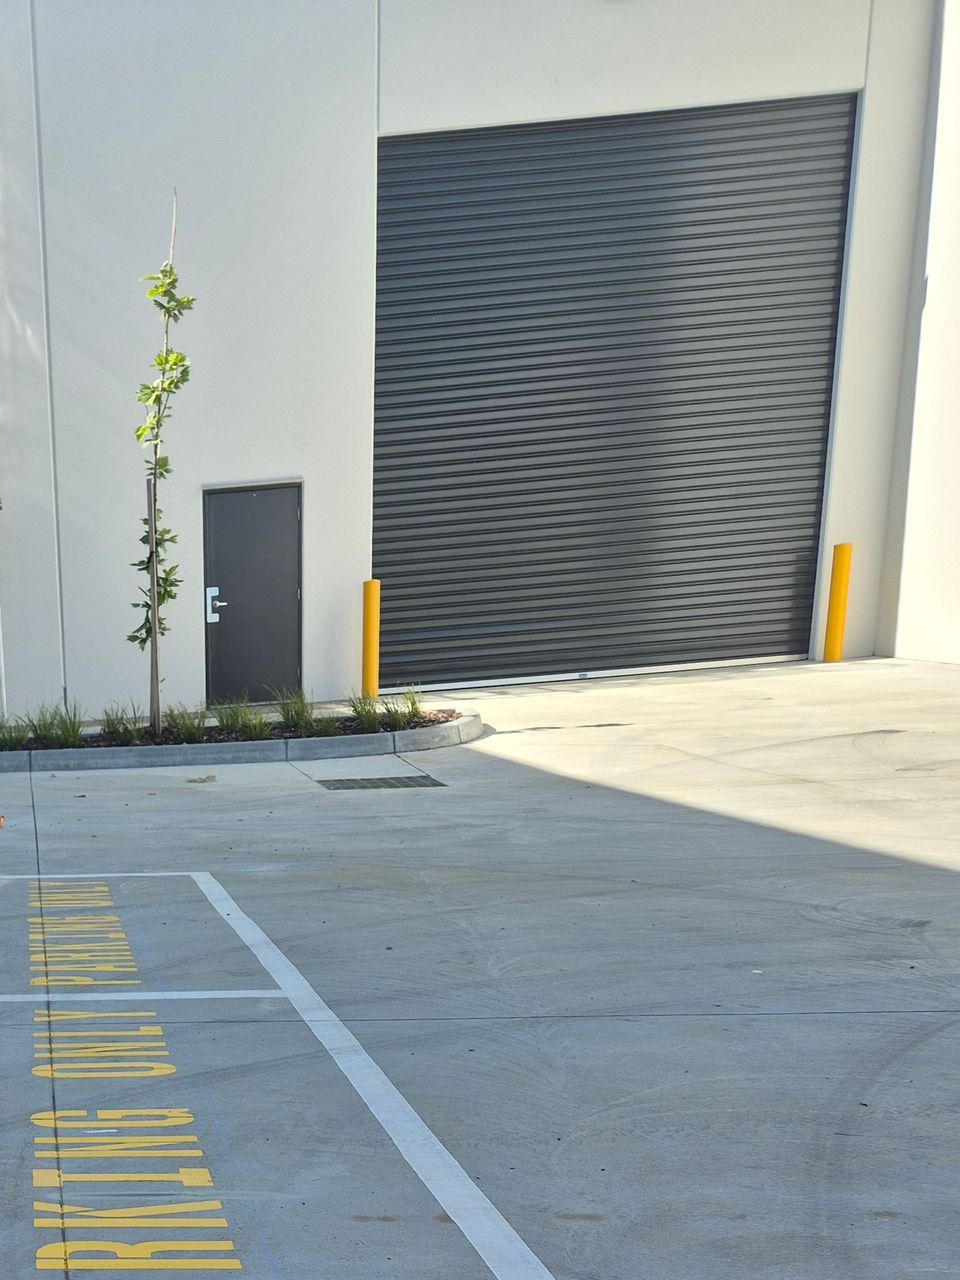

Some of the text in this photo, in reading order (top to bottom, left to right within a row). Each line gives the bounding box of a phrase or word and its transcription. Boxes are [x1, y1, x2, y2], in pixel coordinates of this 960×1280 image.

[27, 881, 142, 987] PARKING ONLY
[30, 1010, 177, 1080] ONLY
